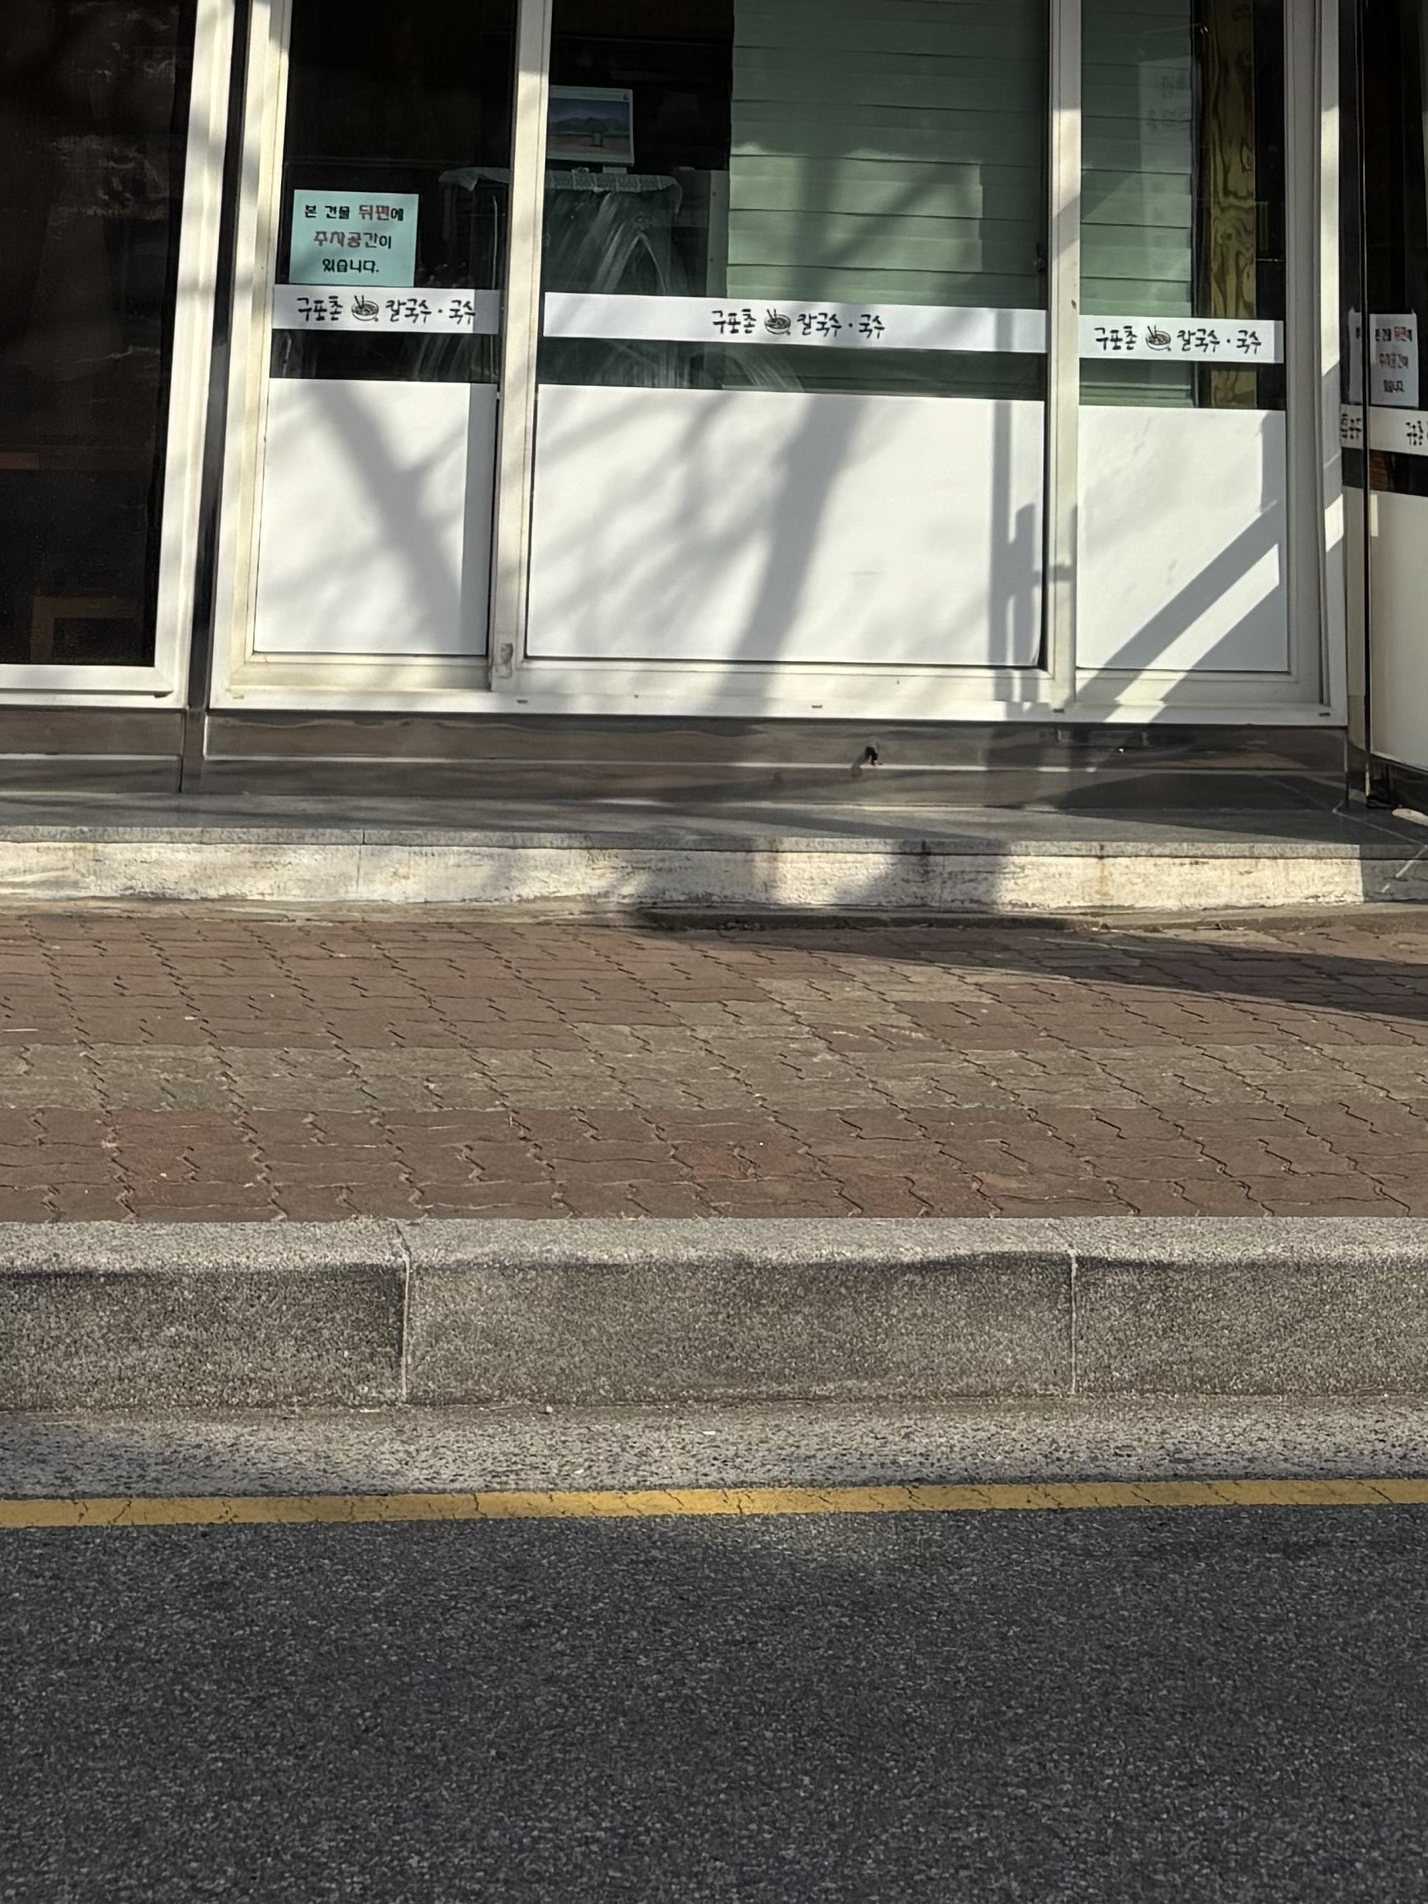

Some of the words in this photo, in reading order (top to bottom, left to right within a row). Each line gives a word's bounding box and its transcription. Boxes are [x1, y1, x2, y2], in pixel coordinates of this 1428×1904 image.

[304, 204, 317, 219] 본
[324, 205, 350, 220] 건물
[358, 204, 404, 222] 뒤편에
[313, 231, 392, 249] 주차공간이
[322, 258, 380, 274] 있습니다.
[296, 295, 344, 322] 구포촌
[385, 298, 432, 324] 칼국수
[448, 299, 477, 325] 국수
[711, 308, 757, 334] 구포촌
[796, 312, 842, 338] 칼국수
[858, 314, 885, 339] 국수
[1094, 325, 1138, 351] 구포촌
[1176, 328, 1221, 353] 칼국수
[1236, 330, 1262, 355] 국수
